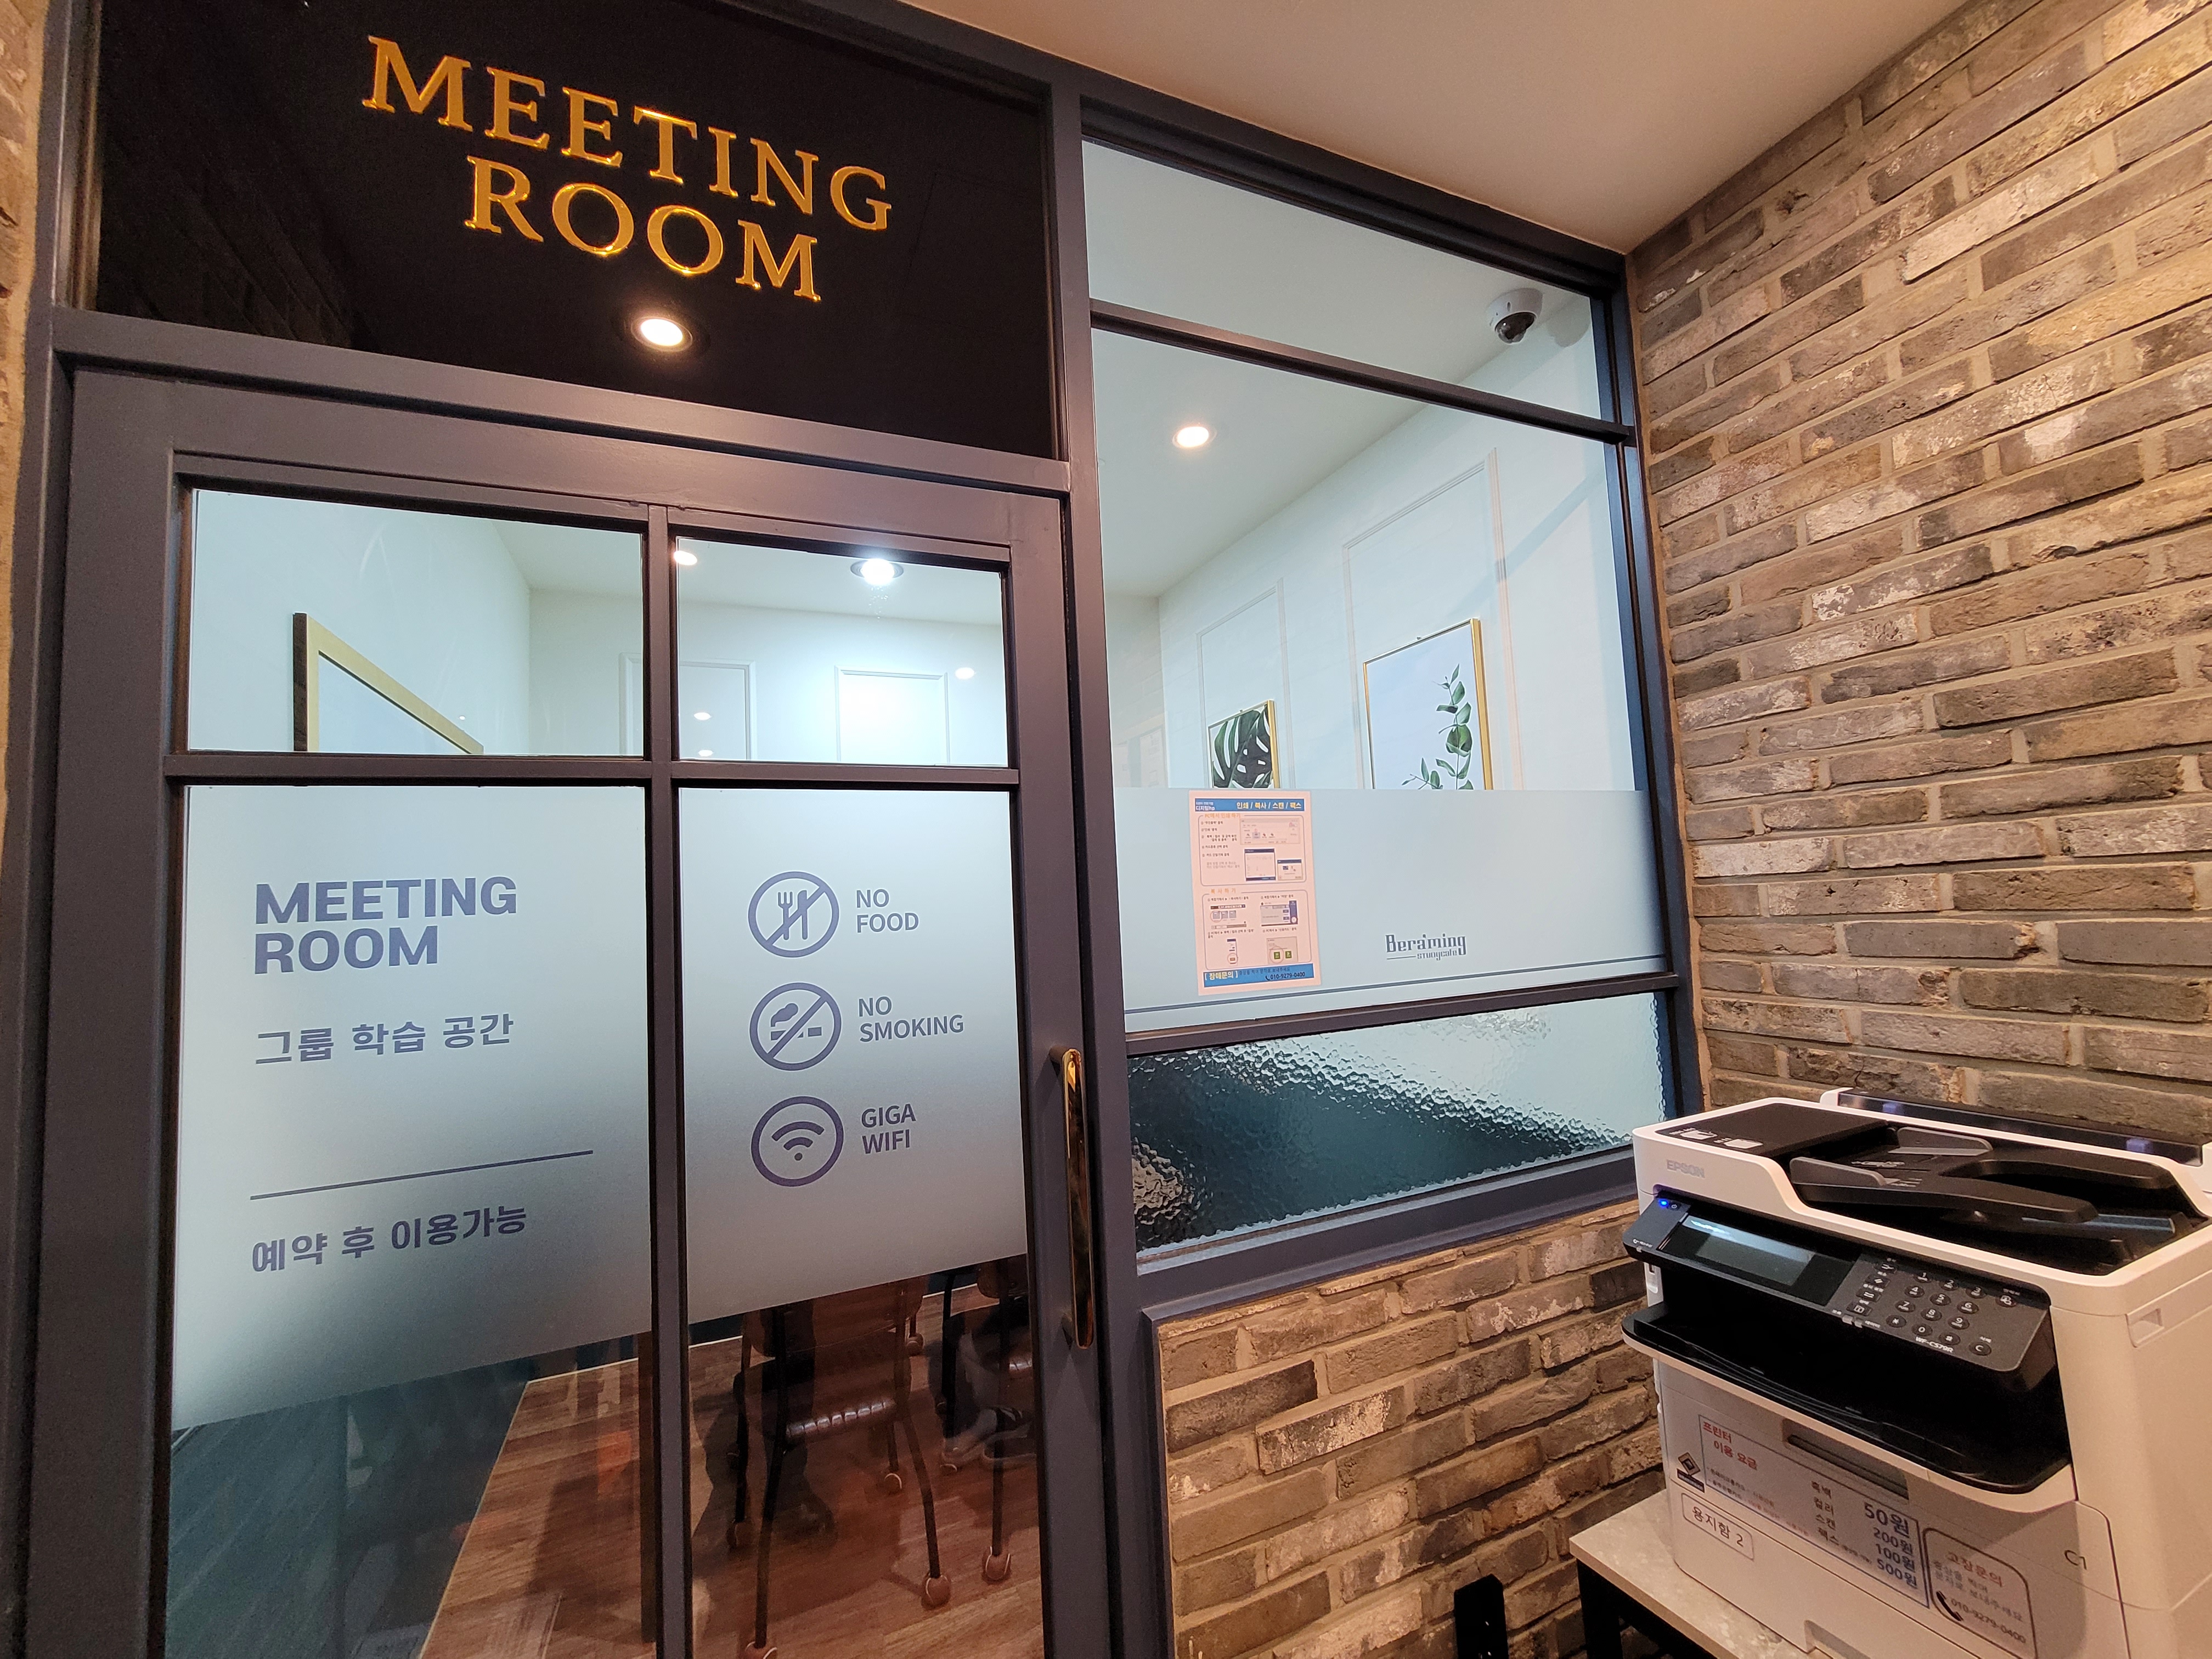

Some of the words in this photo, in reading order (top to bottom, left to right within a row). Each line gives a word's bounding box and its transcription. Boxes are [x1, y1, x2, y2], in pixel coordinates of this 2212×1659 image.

[362, 35, 891, 230] MEETING
[465, 155, 821, 302] ROOM
[255, 877, 517, 924] MEETING
[856, 889, 890, 909] NO
[856, 912, 919, 933] FOOD
[255, 926, 438, 974] ROOM
[858, 996, 893, 1017] NO
[255, 1027, 334, 1064] 그룹
[352, 1021, 426, 1055] 학습
[443, 1013, 514, 1048] 공간
[860, 1014, 964, 1042] SMOKING
[861, 1103, 916, 1128] GIGA
[862, 1129, 911, 1154] WIFI
[1666, 1159, 1705, 1178] EPSON
[252, 1232, 328, 1272] 예약
[341, 1225, 375, 1259] 후
[391, 1206, 527, 1250] 이용가능
[1915, 1336, 1954, 1353] WF-C579R
[1703, 1421, 1731, 1443] 프린터
[1714, 1440, 1734, 1458] 이용
[1737, 1452, 1758, 1471] 요금
[1692, 1506, 1730, 1539] 용지함
[1736, 1533, 1744, 1547] 2
[1812, 1481, 1832, 1499] 흑백
[1864, 1502, 1910, 1538] 50원
[1814, 1496, 1834, 1516] 컬러
[1873, 1527, 1914, 1556] 200원
[1816, 1514, 1837, 1531] 스캔
[1875, 1543, 1916, 1573] 100원
[1818, 1527, 1839, 1545] 팩스
[1876, 1558, 1918, 1589] 500원
[2064, 1549, 2087, 1570] C1
[1947, 1551, 2002, 1587] 고장문의
[1951, 1598, 2026, 1644] 010-9279-0400
